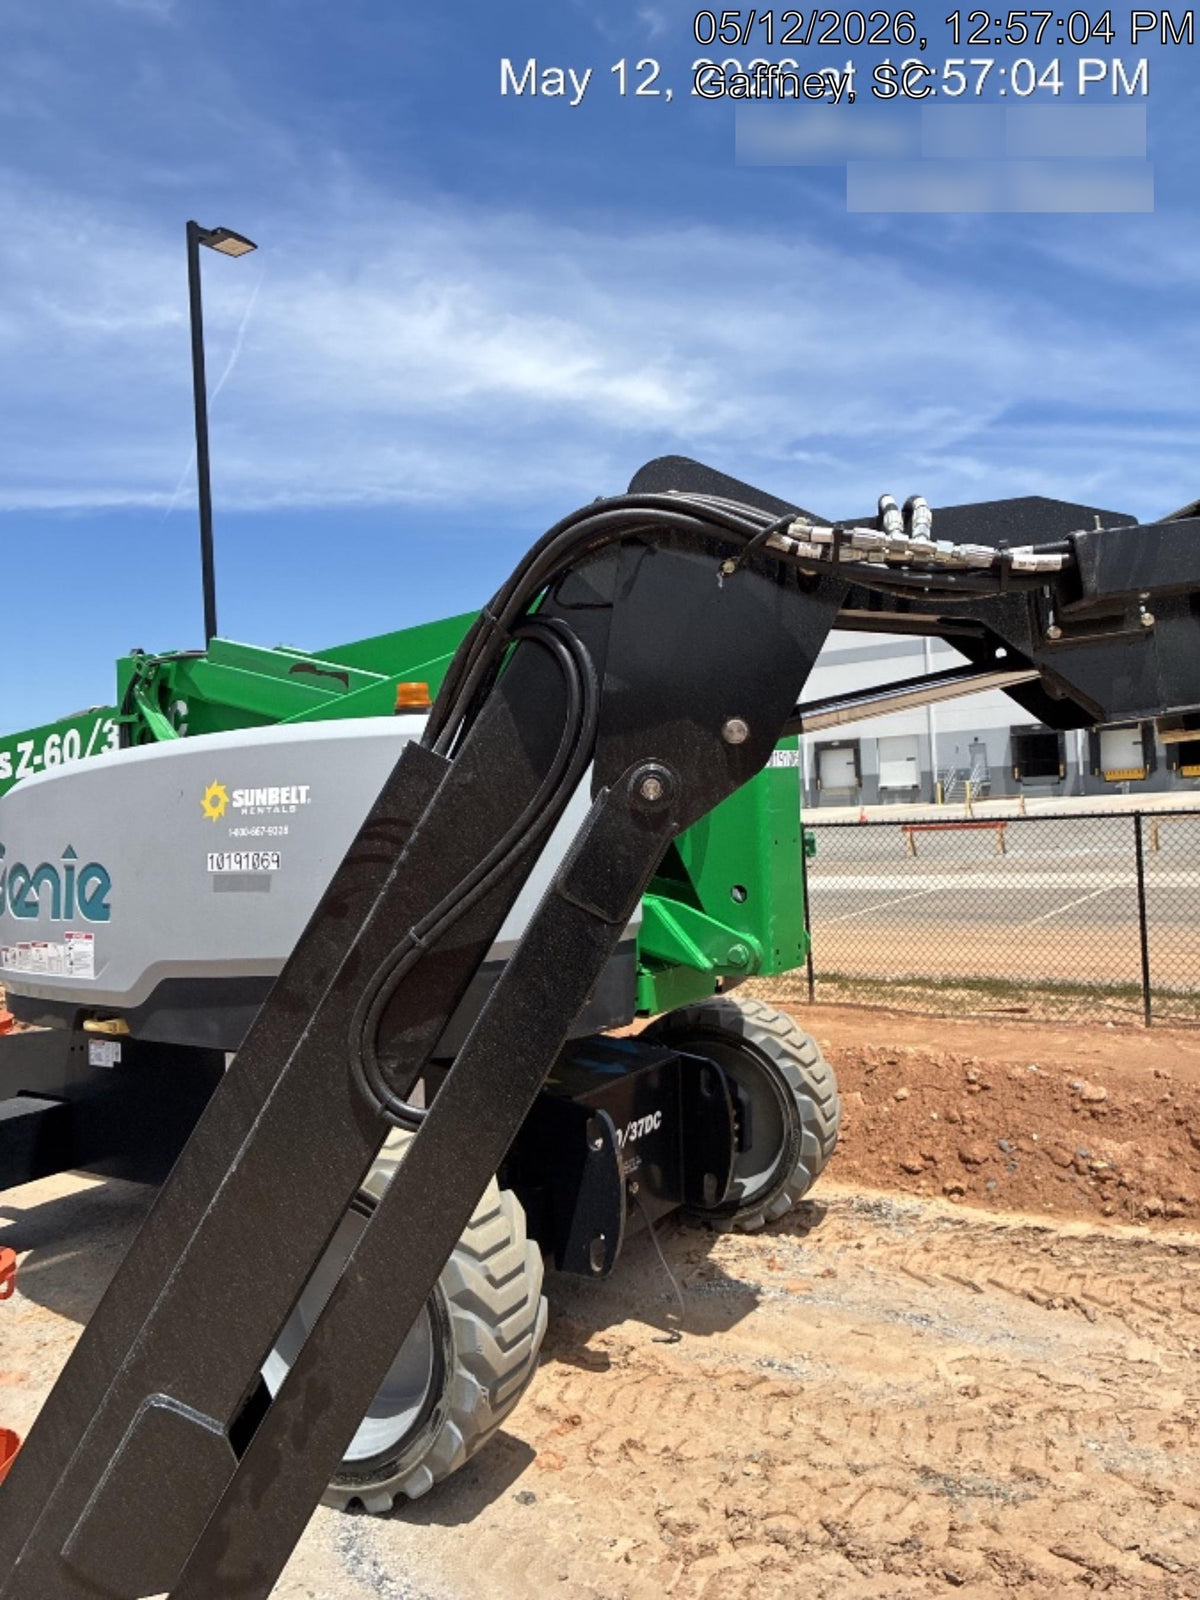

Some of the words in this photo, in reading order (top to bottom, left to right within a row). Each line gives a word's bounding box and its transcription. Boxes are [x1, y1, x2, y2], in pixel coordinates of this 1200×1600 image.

[231, 785, 311, 808] SUNBELT
[241, 805, 297, 815] RENTALS
[208, 852, 280, 871] 10191069
[0, 843, 112, 923] enie
